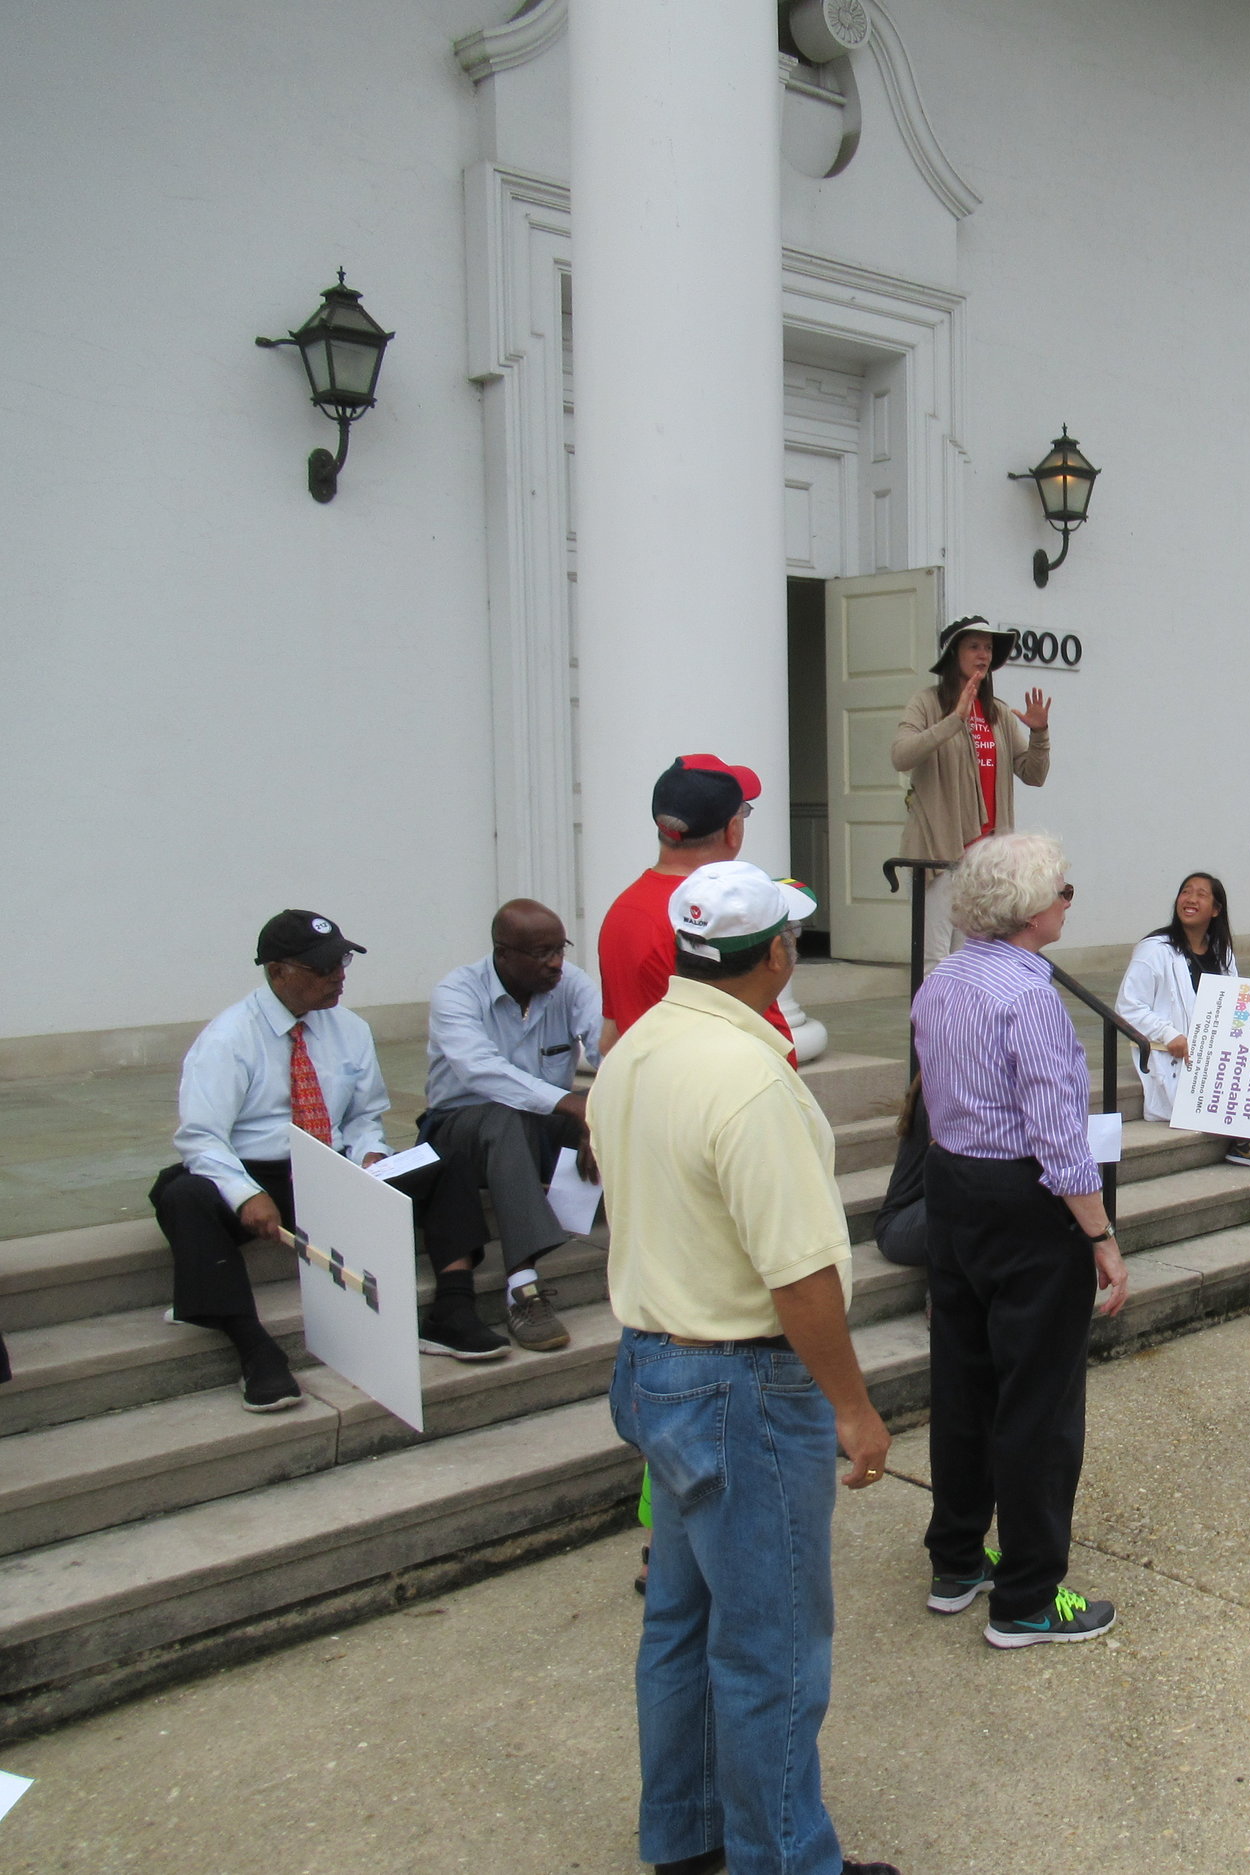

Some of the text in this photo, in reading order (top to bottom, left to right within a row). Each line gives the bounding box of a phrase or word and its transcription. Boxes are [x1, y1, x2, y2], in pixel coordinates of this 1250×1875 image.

[1203, 1011, 1212, 1033] 10700
[1207, 1051, 1232, 1114] Housing
[1224, 1044, 1249, 1125] Affordable
[1196, 1096, 1204, 1113] UMC
